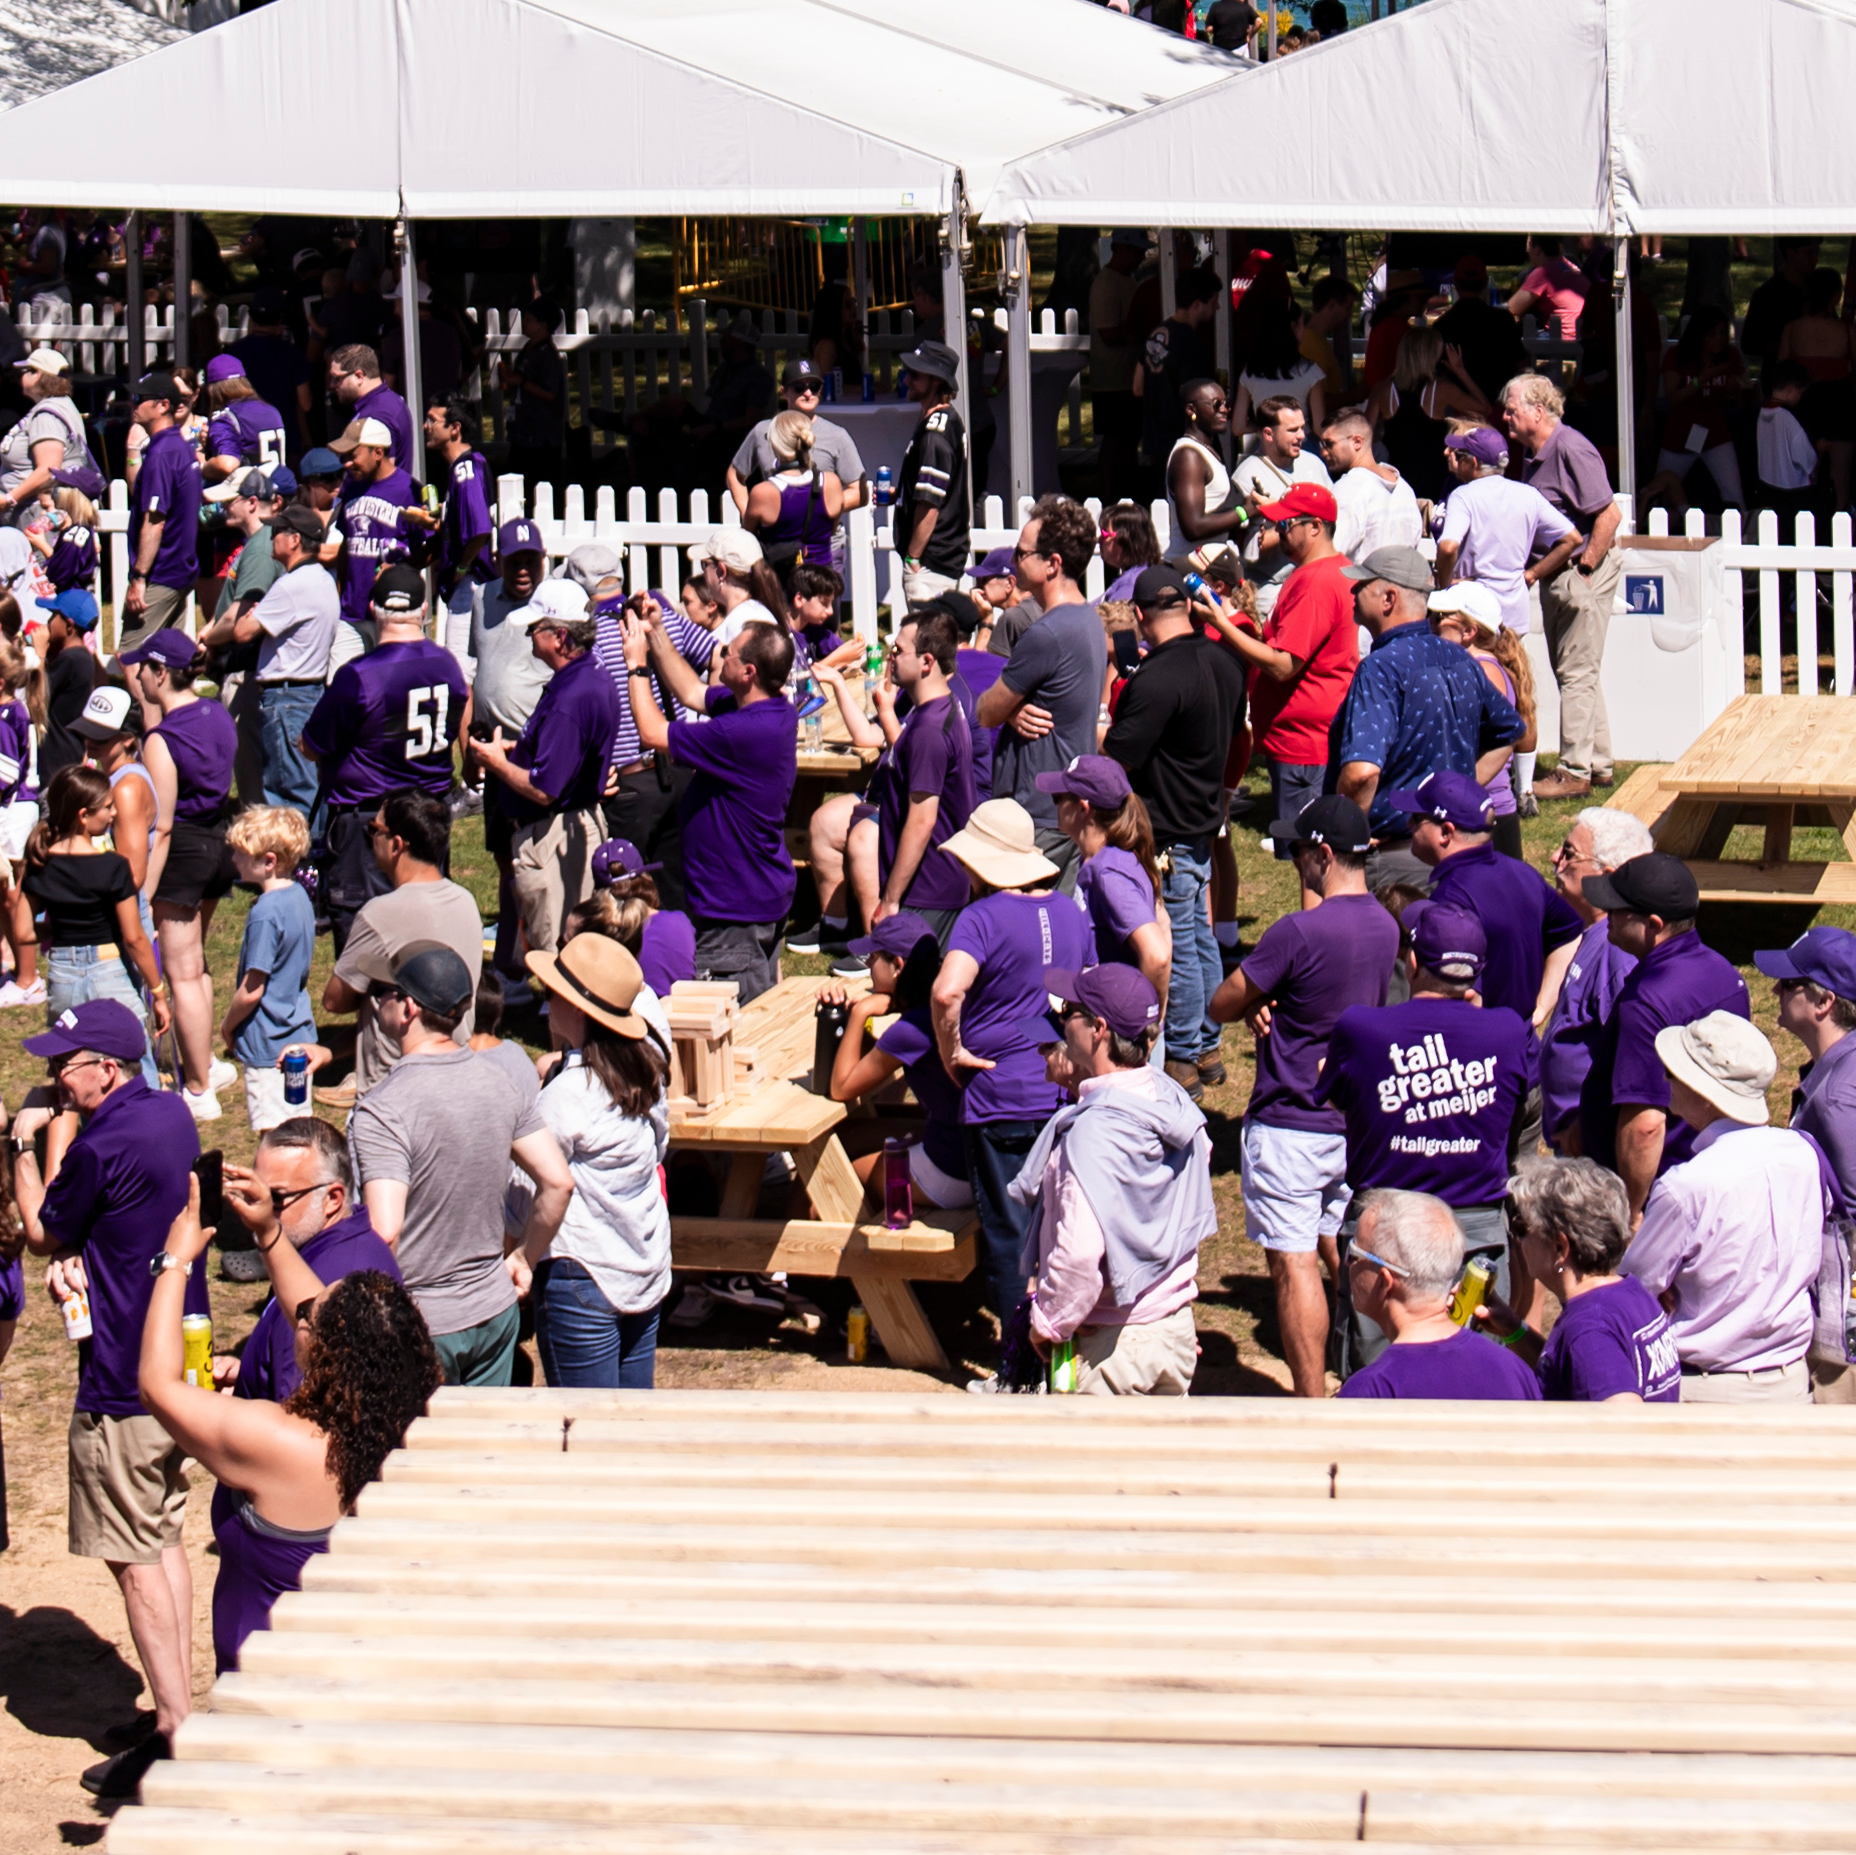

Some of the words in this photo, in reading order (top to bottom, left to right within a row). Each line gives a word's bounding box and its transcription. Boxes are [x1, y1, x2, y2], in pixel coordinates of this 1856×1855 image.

[926, 412, 948, 432] 51
[455, 460, 475, 482] 51
[63, 525, 90, 547] 28
[517, 524, 529, 541] N
[405, 684, 449, 759] 51
[1389, 1033, 1449, 1075] tail
[1377, 1055, 1498, 1113] greater
[1405, 1102, 1427, 1124] at
[1428, 1086, 1497, 1116] meijer
[1390, 1135, 1481, 1157] #tailgreater
